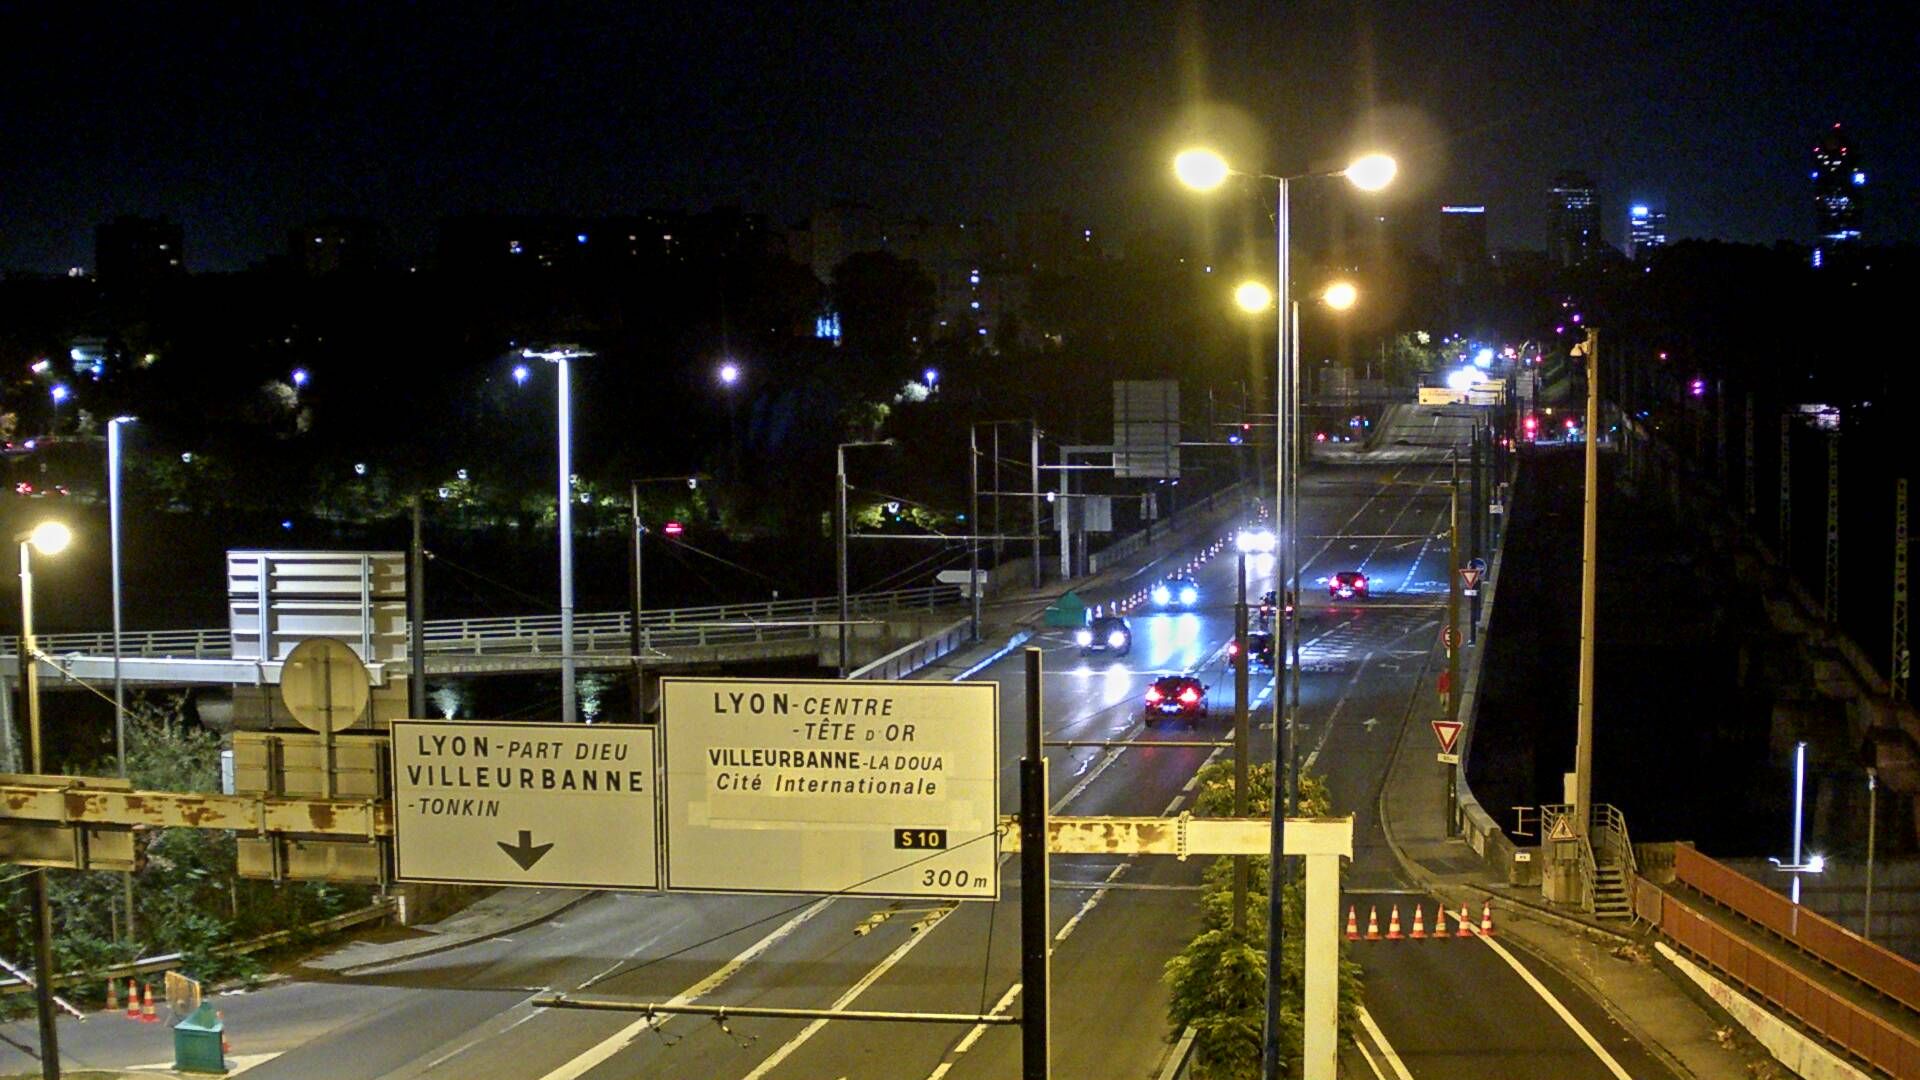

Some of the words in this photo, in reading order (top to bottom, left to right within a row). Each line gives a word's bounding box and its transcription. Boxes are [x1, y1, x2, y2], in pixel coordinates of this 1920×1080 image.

[576, 743, 628, 760] DIEU
[894, 755, 943, 771] DOUA
[408, 765, 643, 792] VILLEURBANNE
[716, 772, 762, 791] Cité
[776, 774, 936, 795] Internationale
[922, 868, 968, 887] 300
[973, 876, 988, 888] m
